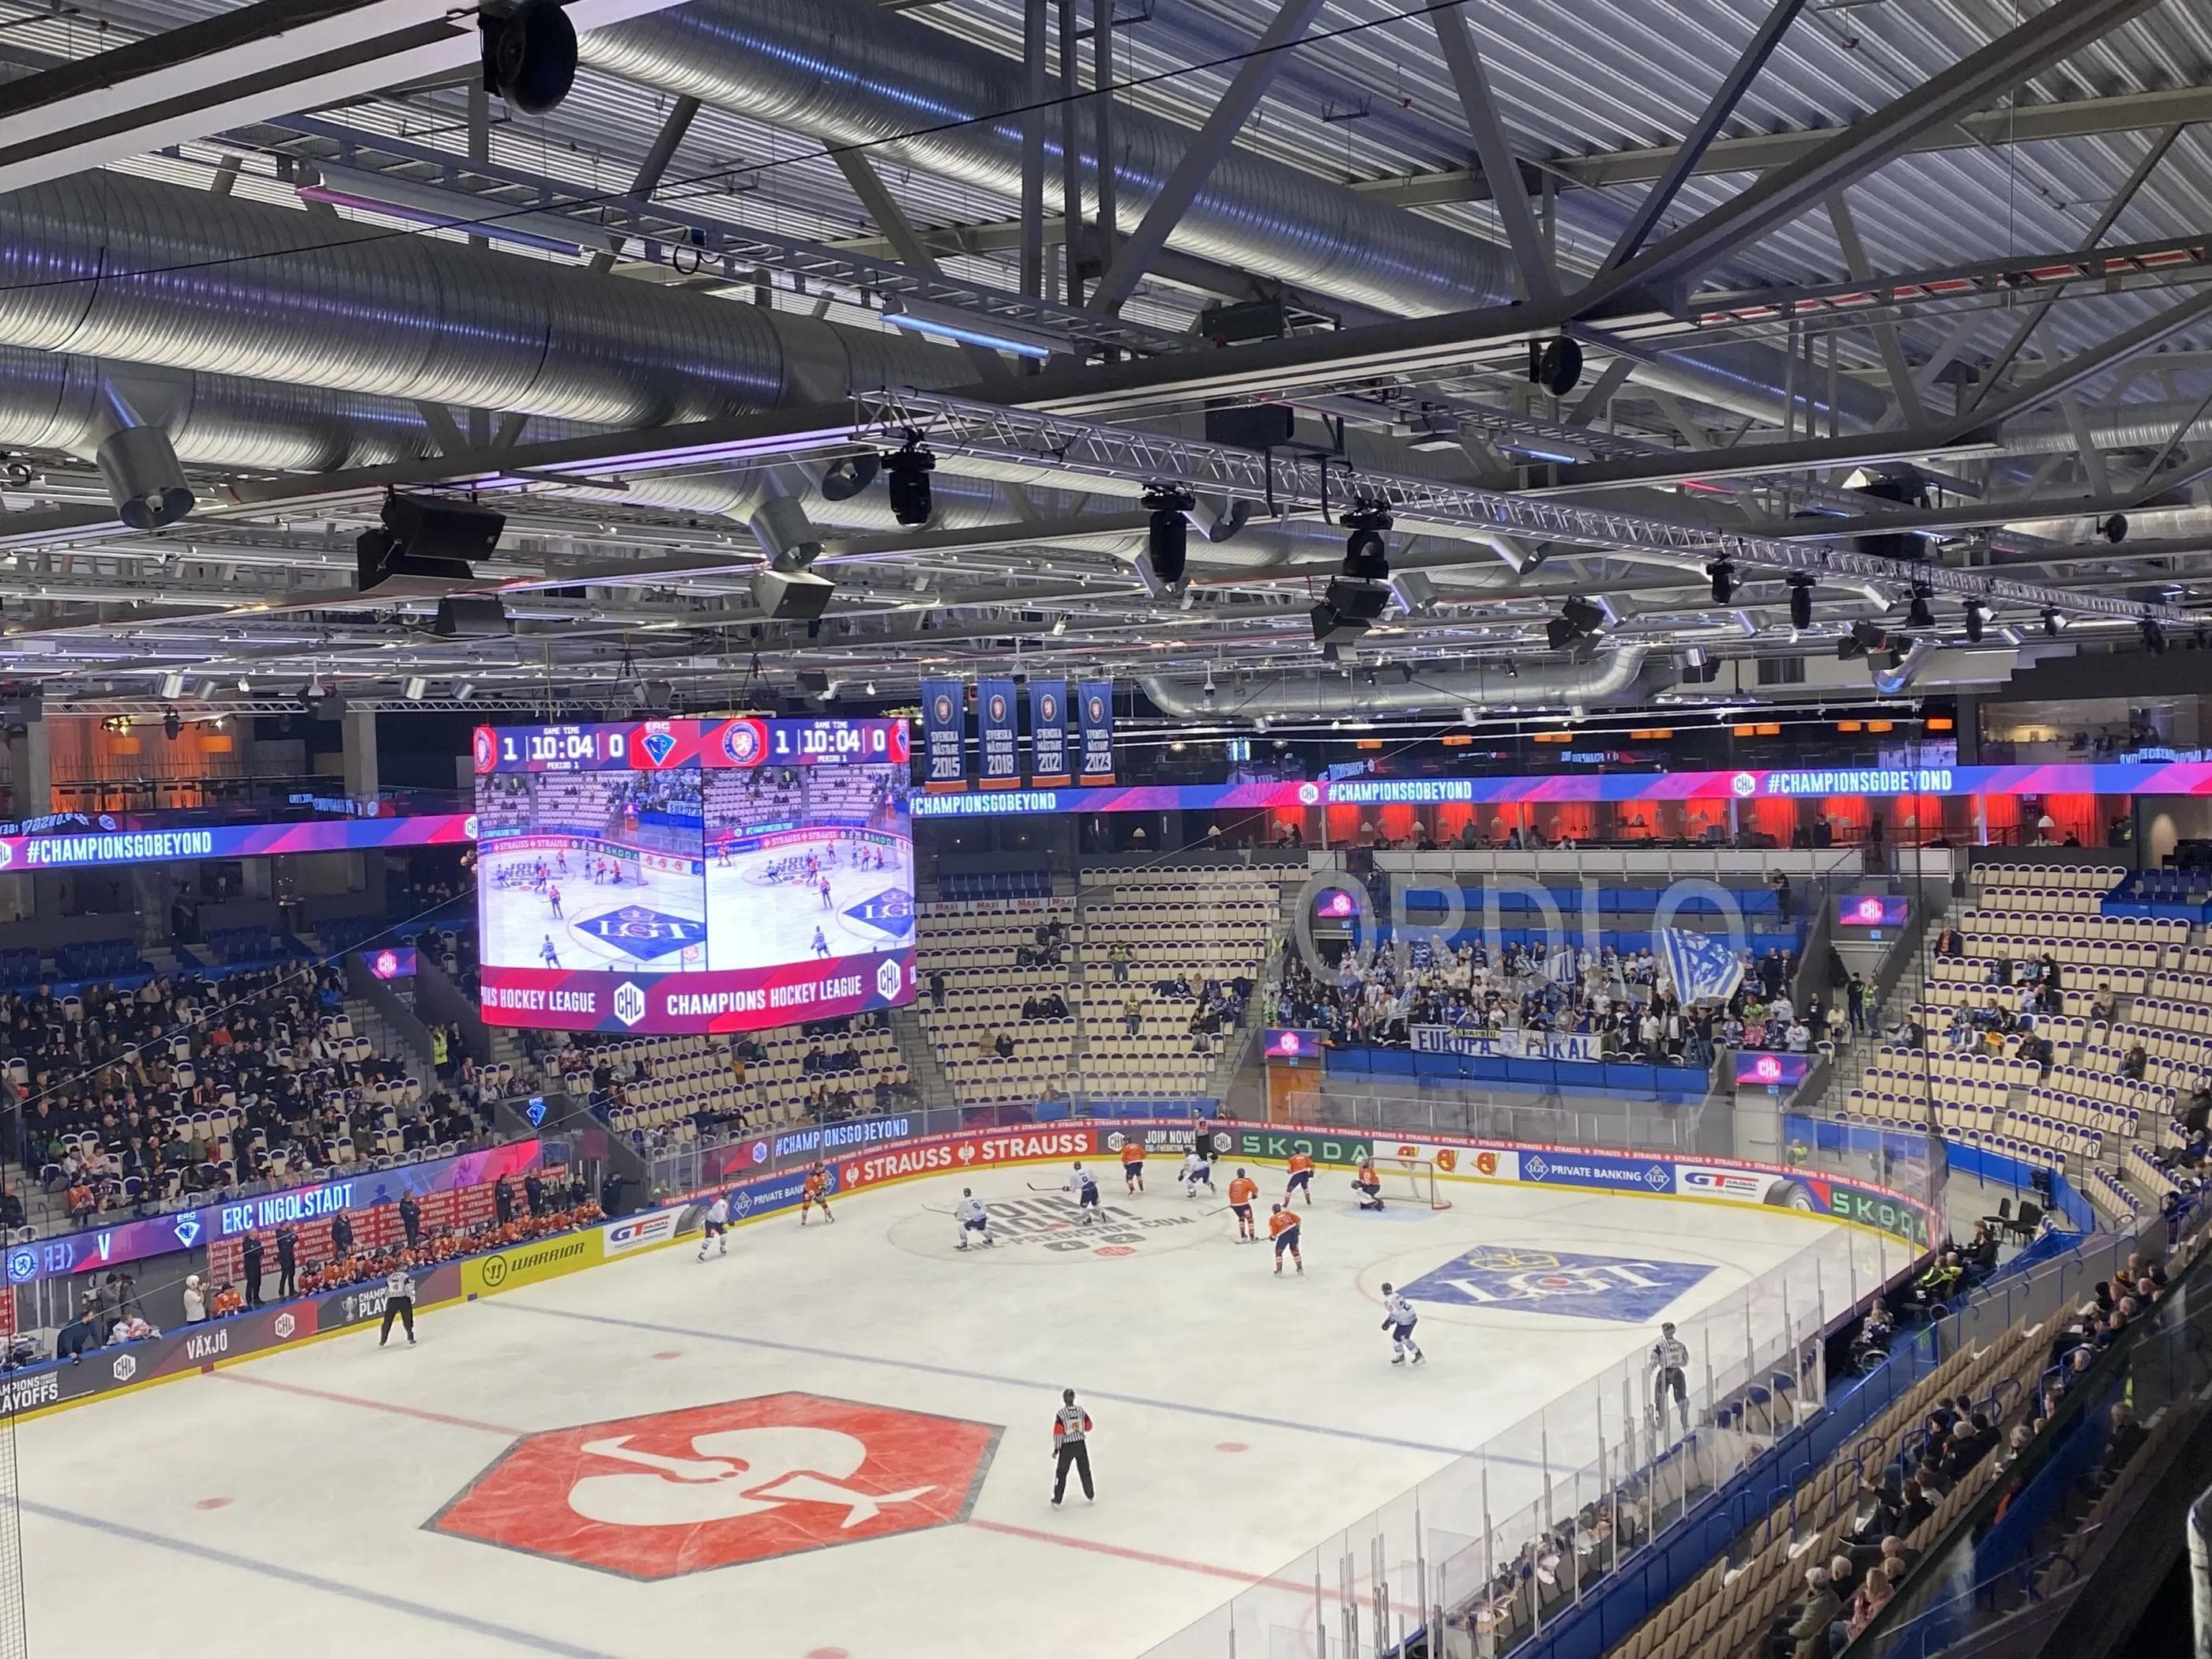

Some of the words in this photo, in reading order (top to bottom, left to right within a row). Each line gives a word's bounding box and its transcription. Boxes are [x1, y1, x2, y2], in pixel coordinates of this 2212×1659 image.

[645, 721, 671, 732] ERC
[503, 738, 517, 760] 1
[532, 735, 594, 759] 10:04
[609, 734, 623, 758] 0
[776, 730, 789, 753] 1
[803, 730, 860, 752] 10:04
[872, 729, 886, 751] 0
[931, 757, 961, 777] 2015
[988, 754, 1014, 775] 2018
[1038, 752, 1063, 772] 2021
[1085, 753, 1112, 772] 2023
[1328, 780, 1472, 802] #CHAMPIONSGOBEYOND
[1768, 769, 1953, 794] #CHAMPIONSGOBEYOND
[909, 792, 1056, 814] #CHAMPIONSGOBEYOND
[27, 831, 212, 863] #CHAMPIONSGOBEYOND
[880, 969, 899, 991] CHL
[500, 989, 546, 1010] HOCKEY
[549, 991, 596, 1013] LEAGUE
[617, 992, 642, 1018] CHL
[667, 988, 766, 1016] CHAMPIONS
[770, 983, 817, 1008] HOCKEY
[820, 975, 862, 999] LEAGUE
[775, 1119, 908, 1157] #CHAMPONSGOBEYOND
[1145, 1130, 1168, 1144] JOIN
[1169, 1130, 1196, 1144] NOW!
[1216, 1137, 1230, 1148] CHL
[864, 1147, 952, 1180] STRAUSS
[982, 1134, 1088, 1160] STRAUSS
[1243, 1136, 1368, 1161] SKODA
[1551, 1164, 1591, 1178] PRIVATE
[1594, 1168, 1642, 1181] BANKING
[1650, 1175, 1666, 1183] LGT
[754, 1191, 783, 1205] PRIVATE
[784, 1184, 804, 1197] BANK
[177, 1211, 196, 1222] ERC
[221, 1206, 254, 1234] ERC
[259, 1183, 352, 1226] INGOLSTADT
[986, 1196, 1082, 1218] OIN
[98, 1232, 111, 1261] V
[511, 1242, 585, 1272] WARRIOR
[1434, 1262, 1672, 1304] LGT
[277, 1317, 294, 1334] CHL
[186, 1329, 228, 1360] VÄXJÖ
[115, 1357, 134, 1377] CHL
